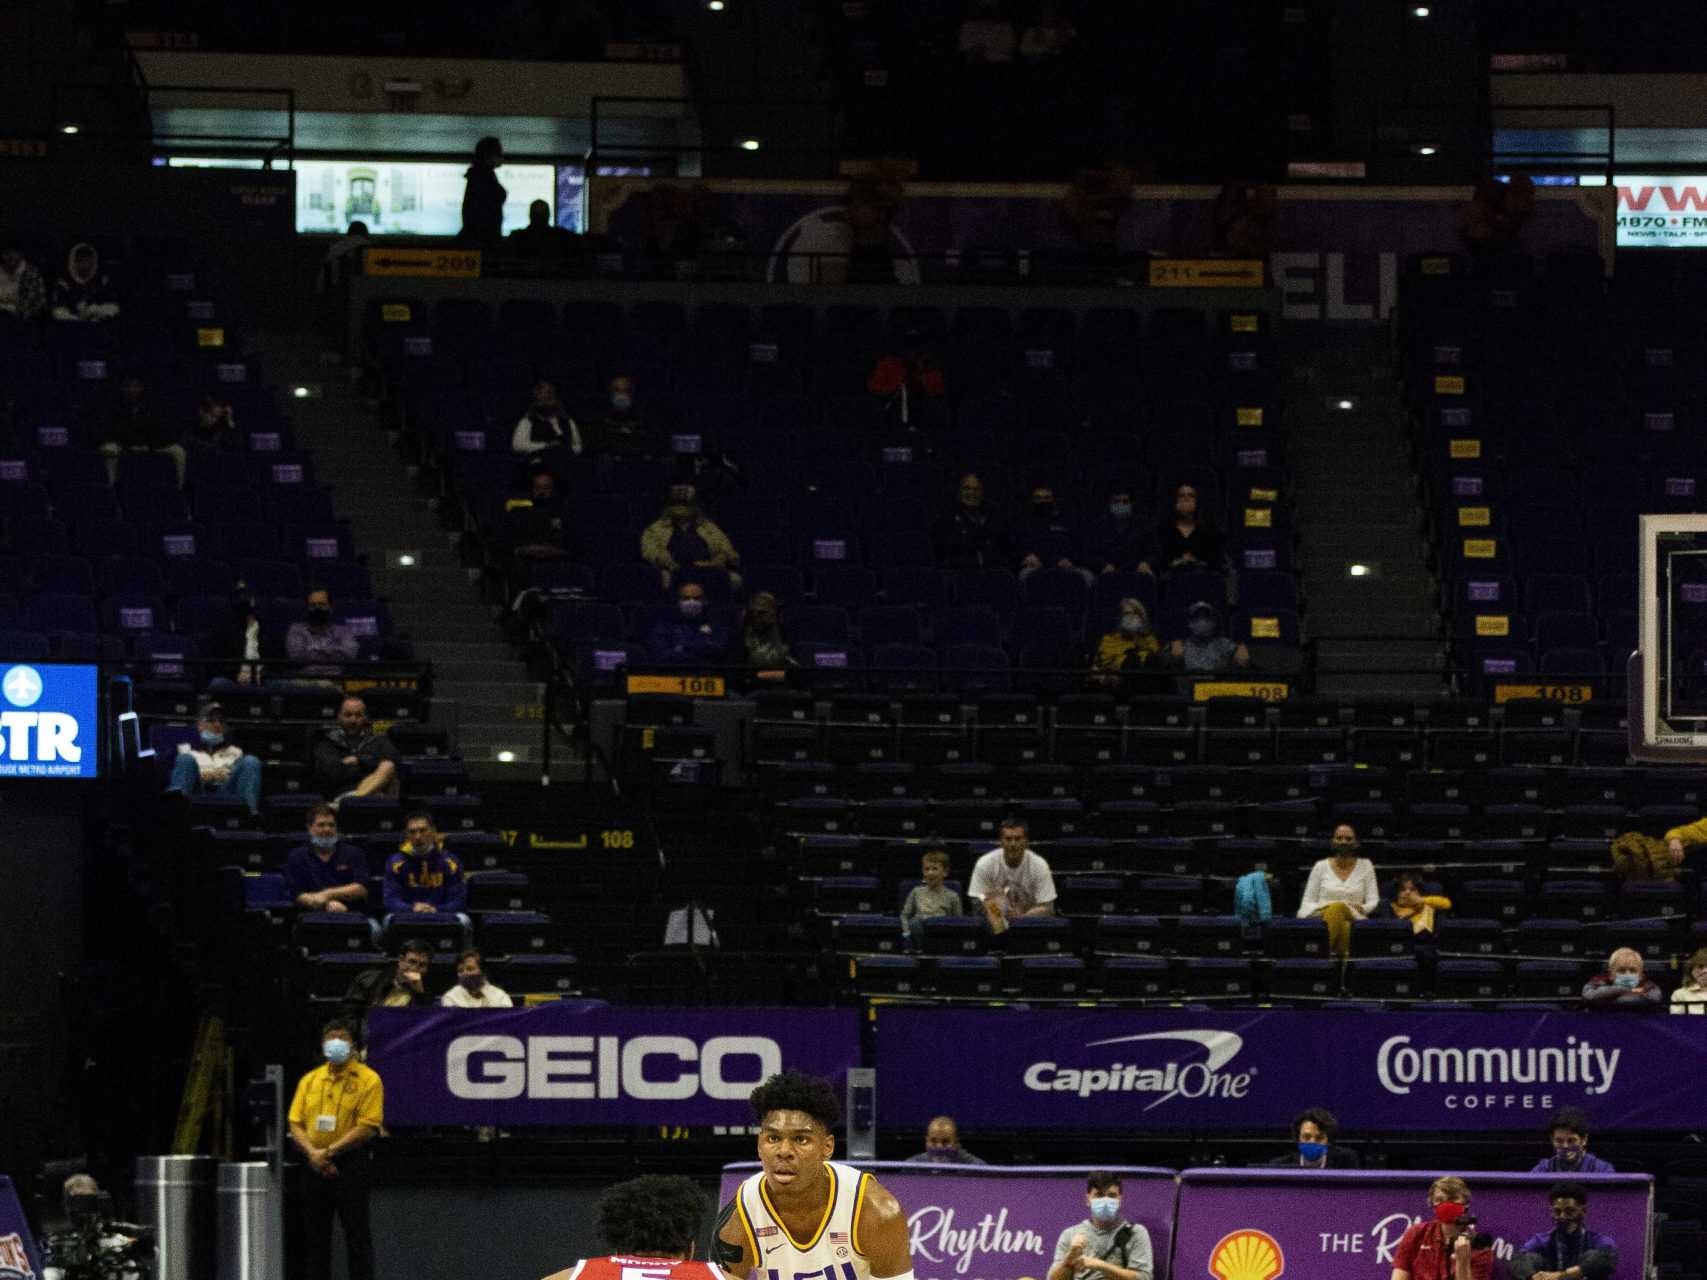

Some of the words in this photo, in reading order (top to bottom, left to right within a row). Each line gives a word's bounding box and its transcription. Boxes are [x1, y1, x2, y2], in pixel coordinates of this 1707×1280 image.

[0, 710, 82, 763] TR
[600, 830, 634, 848] 108
[446, 1035, 783, 1100] GEICO
[1376, 1035, 1621, 1095] Community
[1444, 1095, 1554, 1109] COFFEE
[906, 1205, 1045, 1274] Rhythm
[1319, 1233, 1364, 1253] THE
